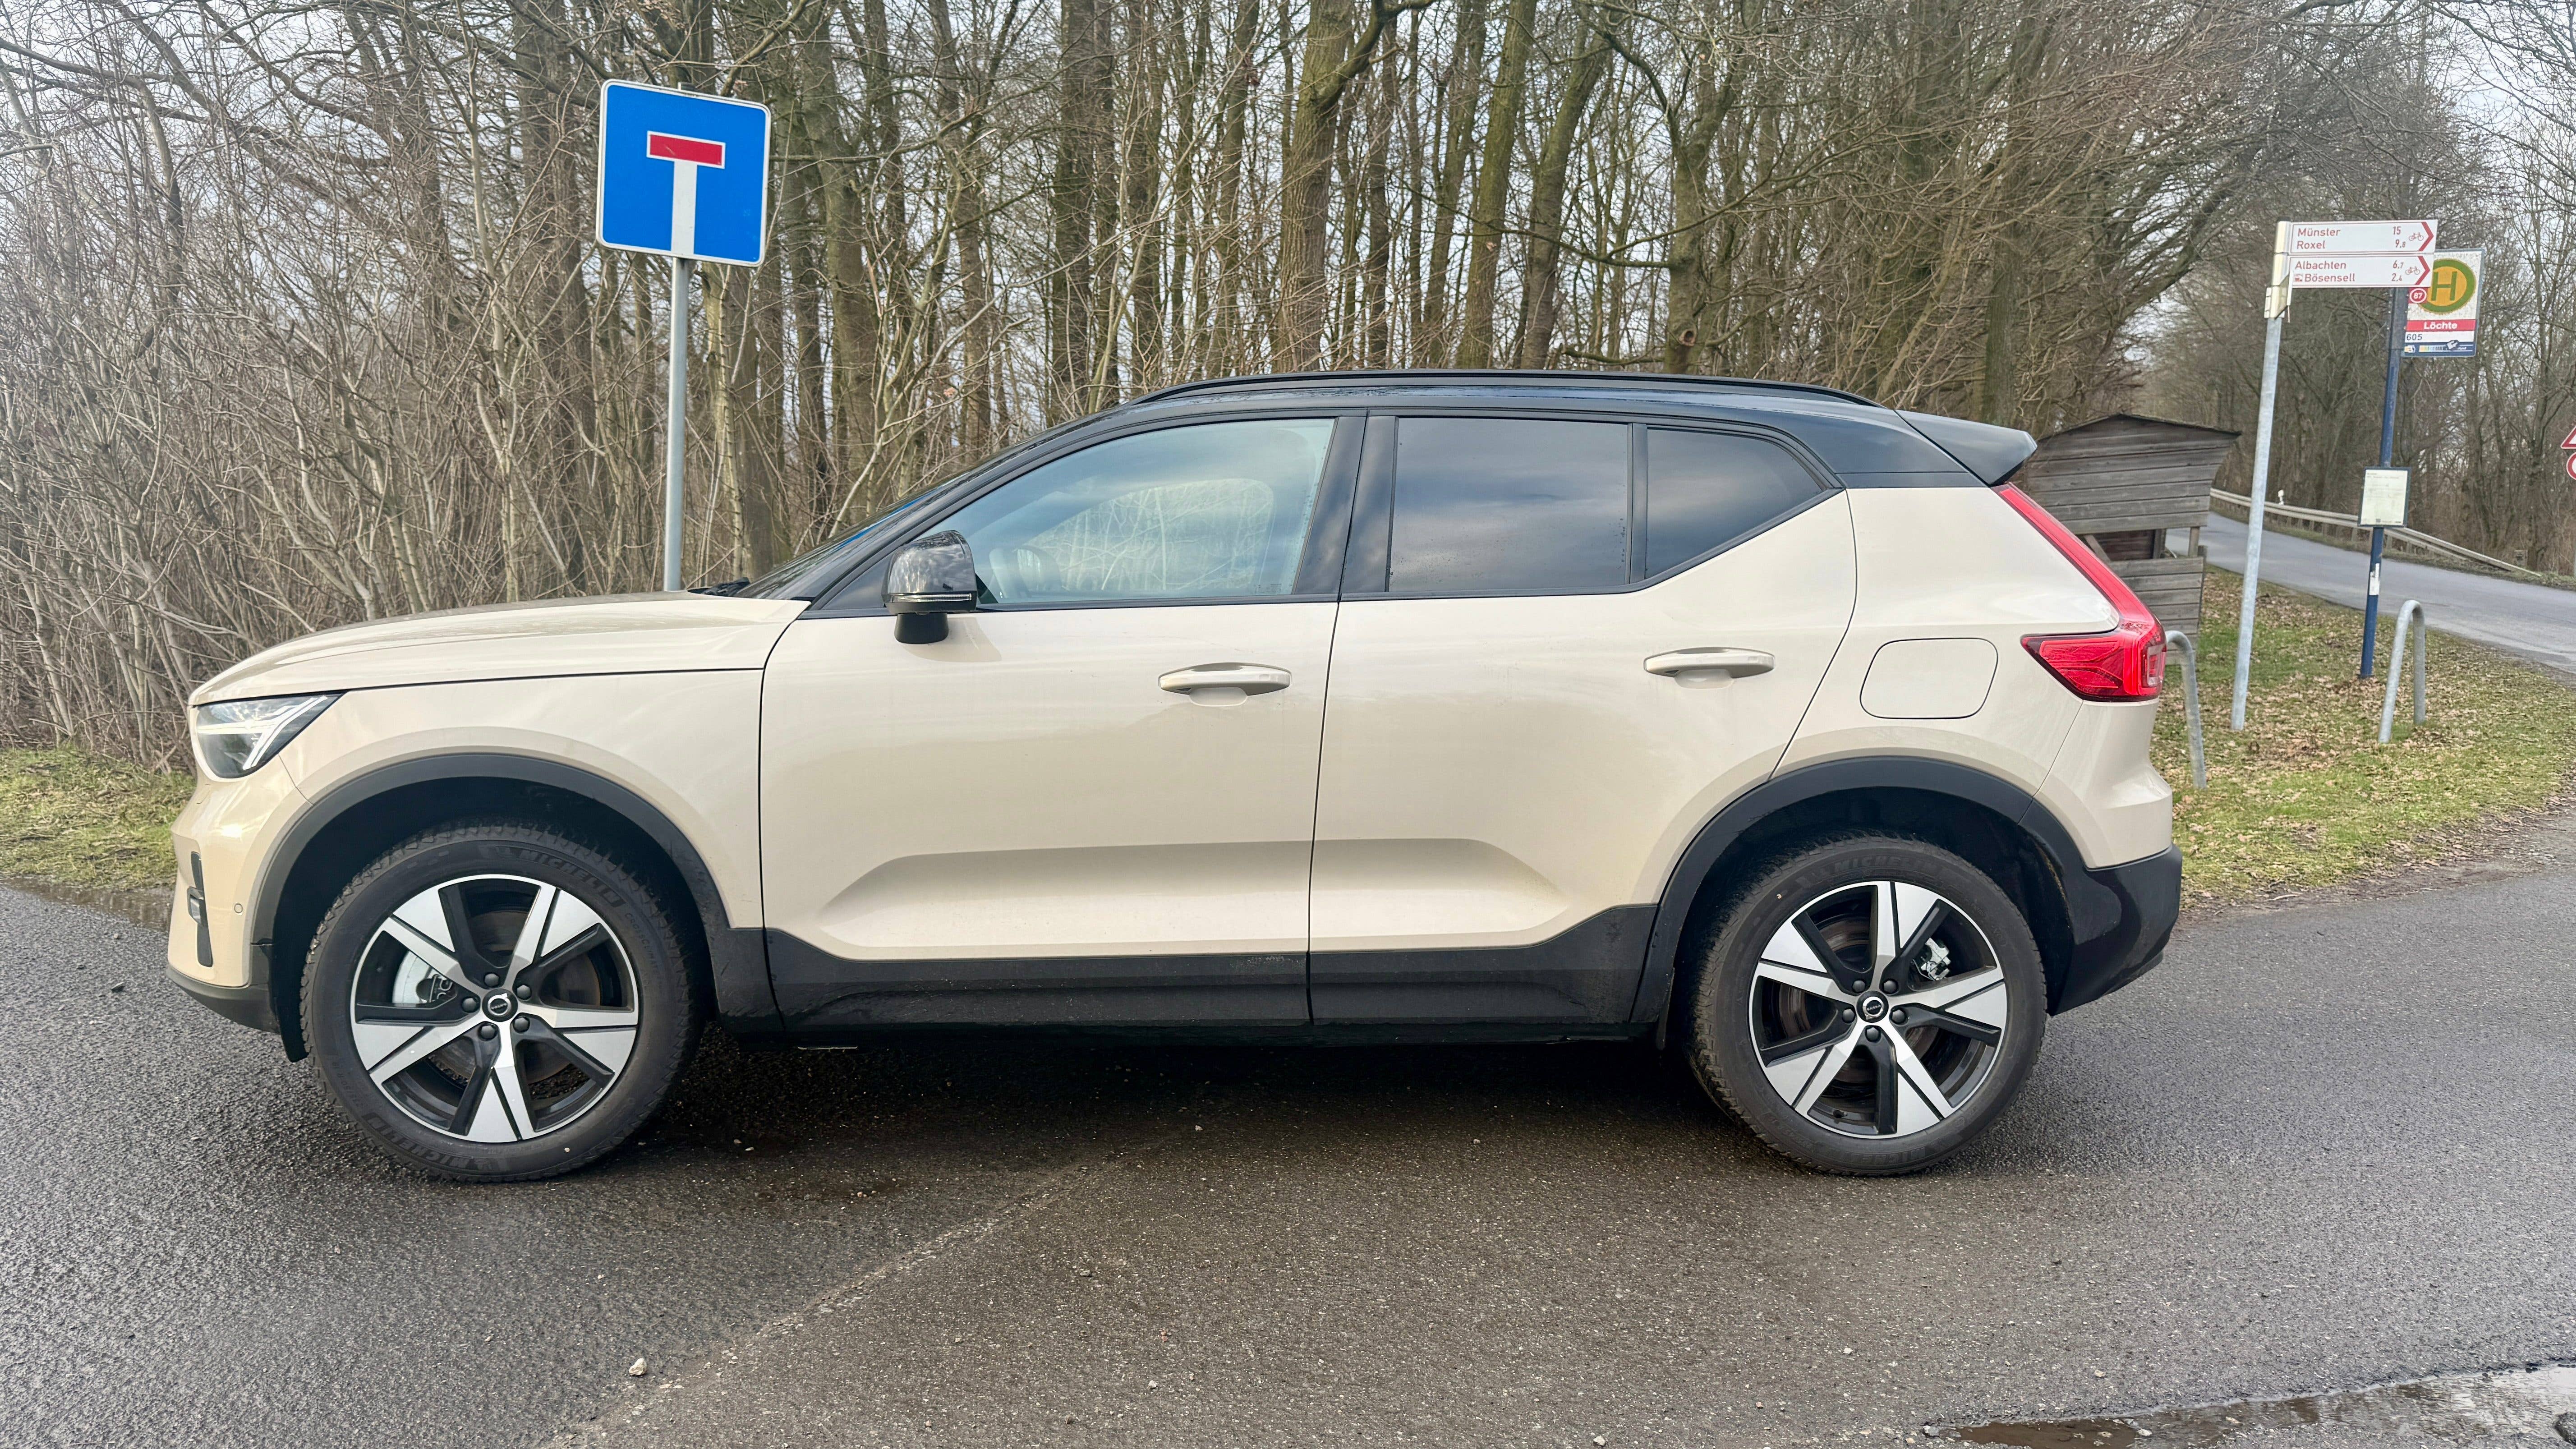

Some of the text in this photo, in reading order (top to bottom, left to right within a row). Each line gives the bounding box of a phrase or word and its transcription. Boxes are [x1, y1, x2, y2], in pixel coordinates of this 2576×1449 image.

[2298, 226, 2401, 237] Münster 15
[2297, 240, 2325, 249] Roxel
[2295, 260, 2404, 270] Albachten 6.7
[2305, 273, 2355, 282] Bösensell
[2431, 271, 2457, 301] H
[2424, 321, 2458, 330] Löchte
